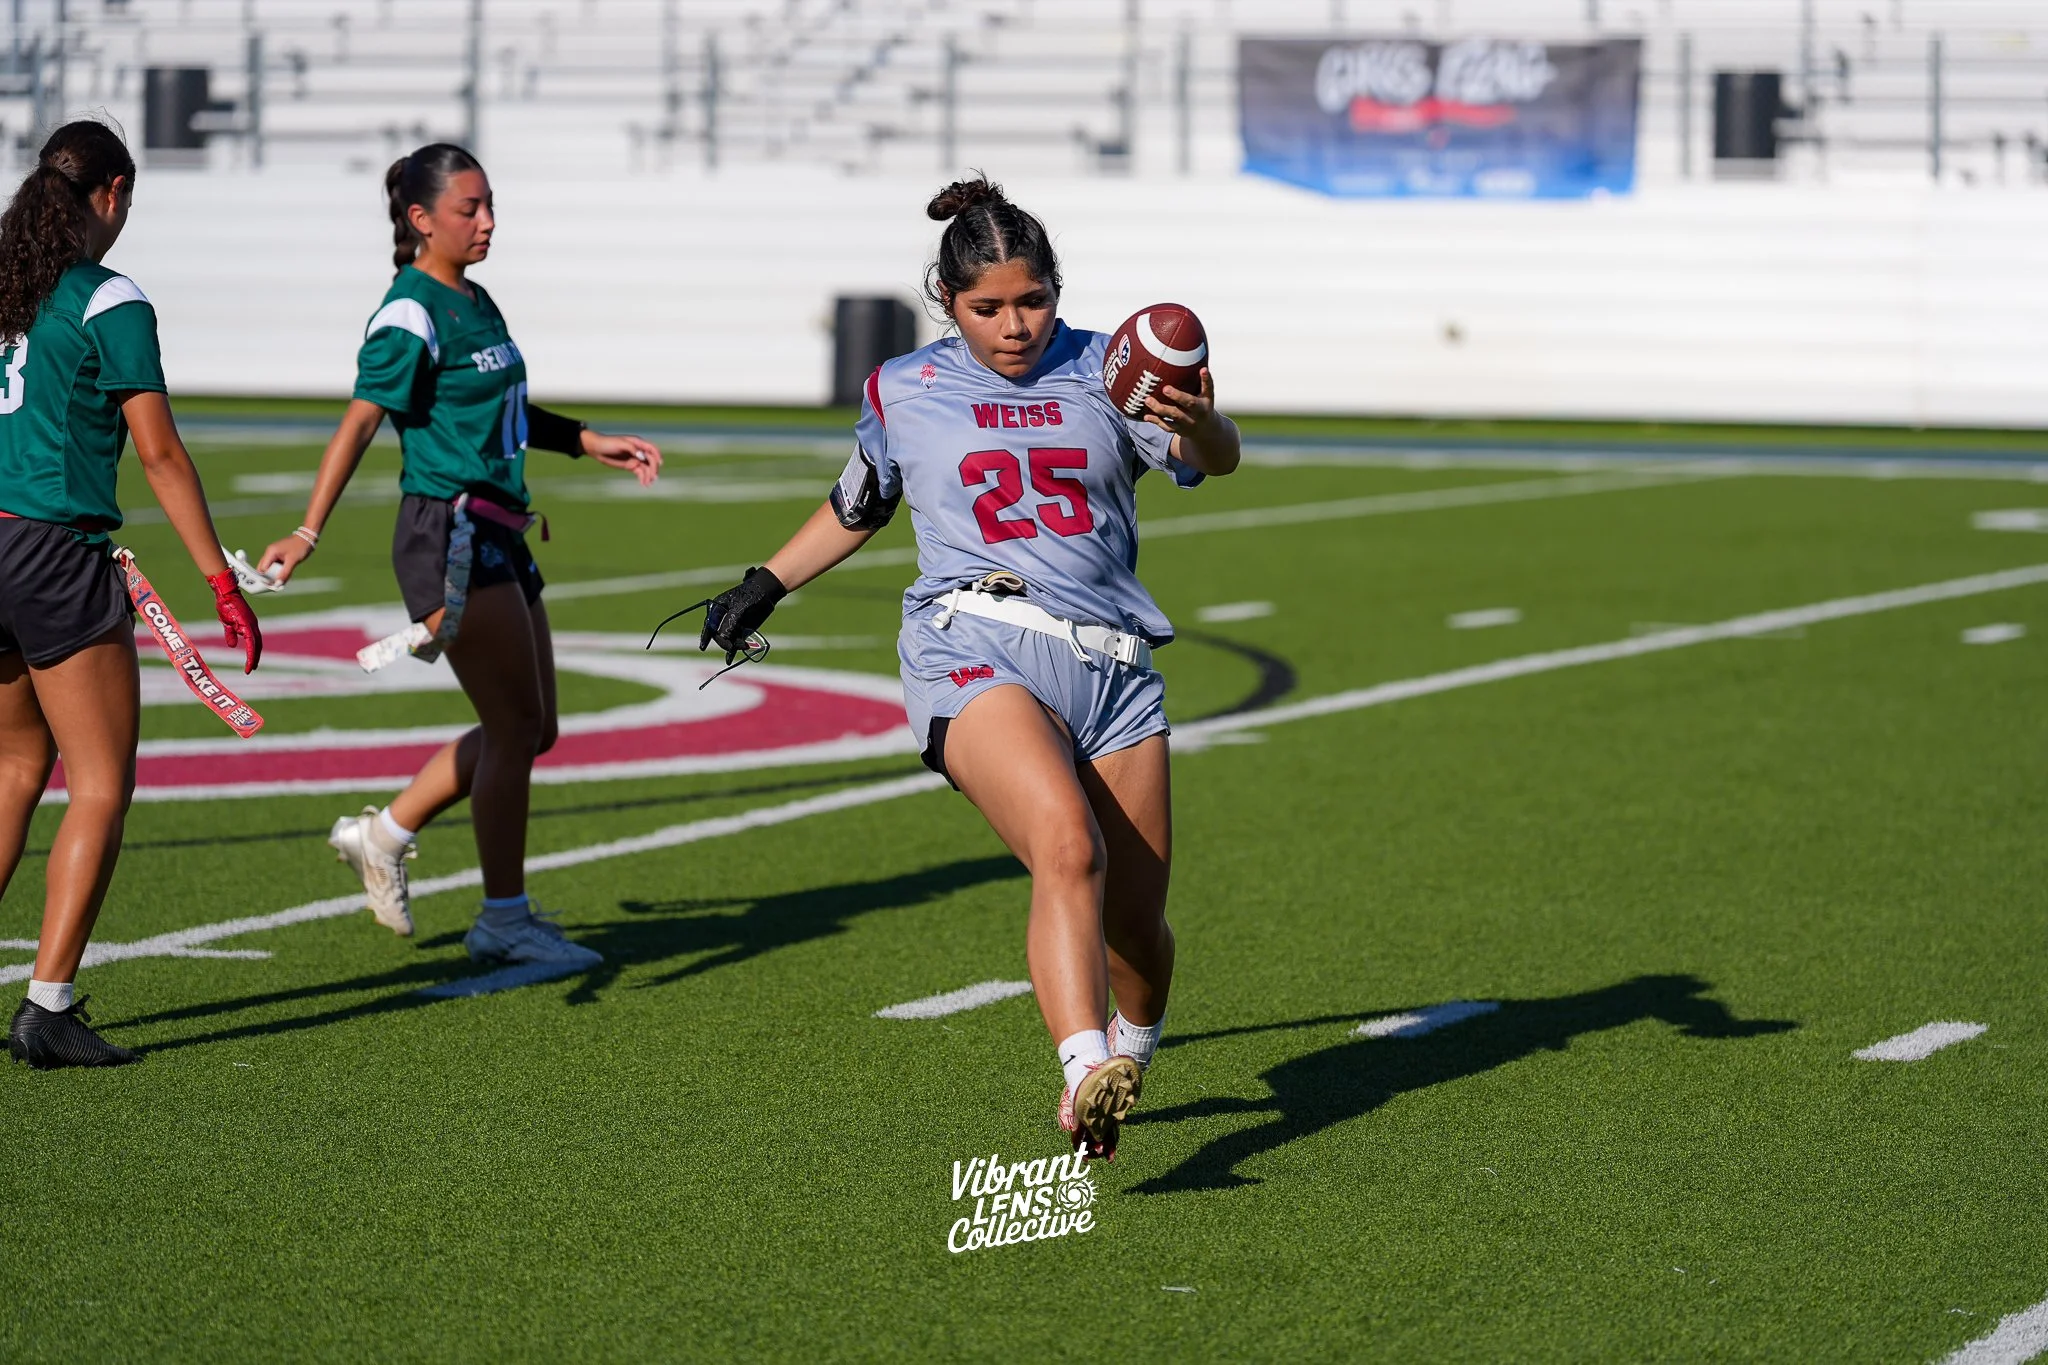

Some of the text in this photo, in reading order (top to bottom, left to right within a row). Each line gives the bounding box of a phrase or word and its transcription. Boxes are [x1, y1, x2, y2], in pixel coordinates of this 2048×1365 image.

[1104, 356, 1124, 390] USA
[971, 401, 1063, 429] WEISS
[958, 448, 1094, 545] 25
[144, 601, 187, 653] COME
[174, 648, 192, 661] AND
[182, 655, 221, 698] TAKE
[212, 693, 238, 710] IT
[227, 704, 249, 721] TEXAS
[234, 709, 253, 727] FURY
